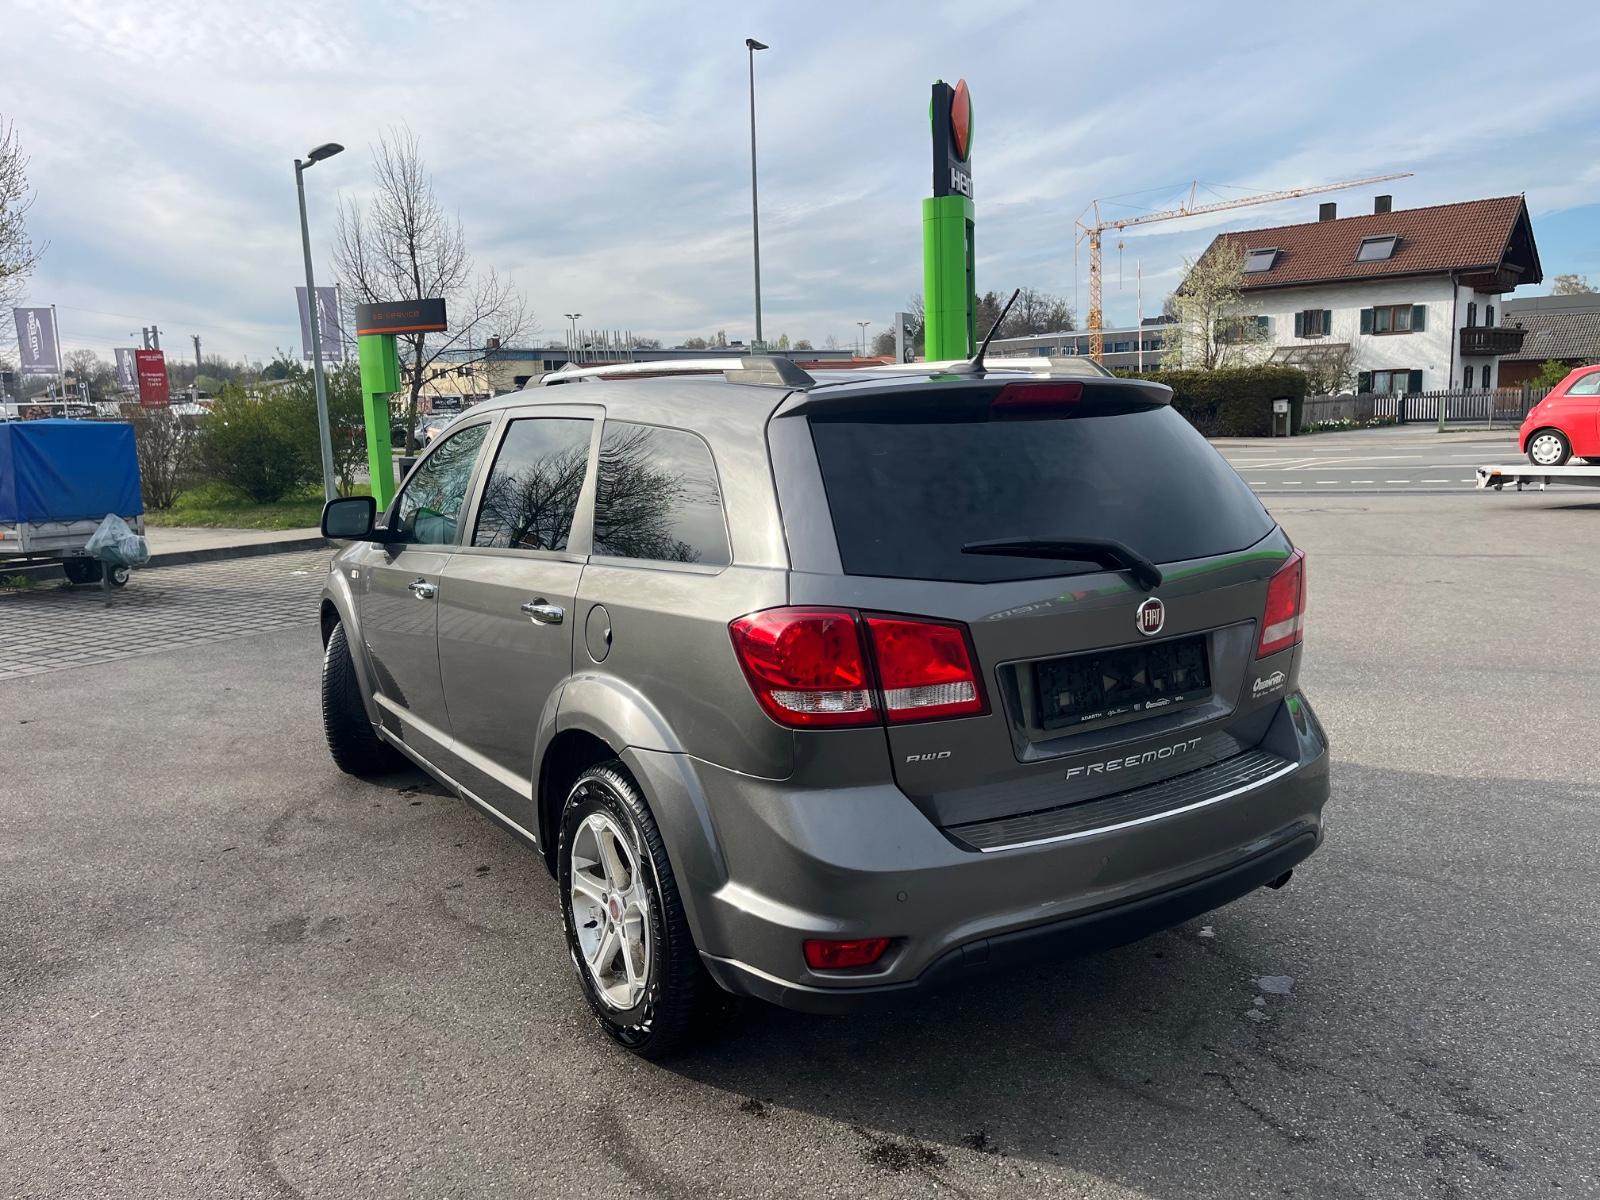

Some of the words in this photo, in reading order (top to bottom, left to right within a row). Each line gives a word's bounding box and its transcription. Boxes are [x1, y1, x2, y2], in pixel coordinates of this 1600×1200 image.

[1144, 608, 1160, 626] FIAT
[906, 751, 951, 762] AWD
[1065, 737, 1202, 780] FREEMONT
